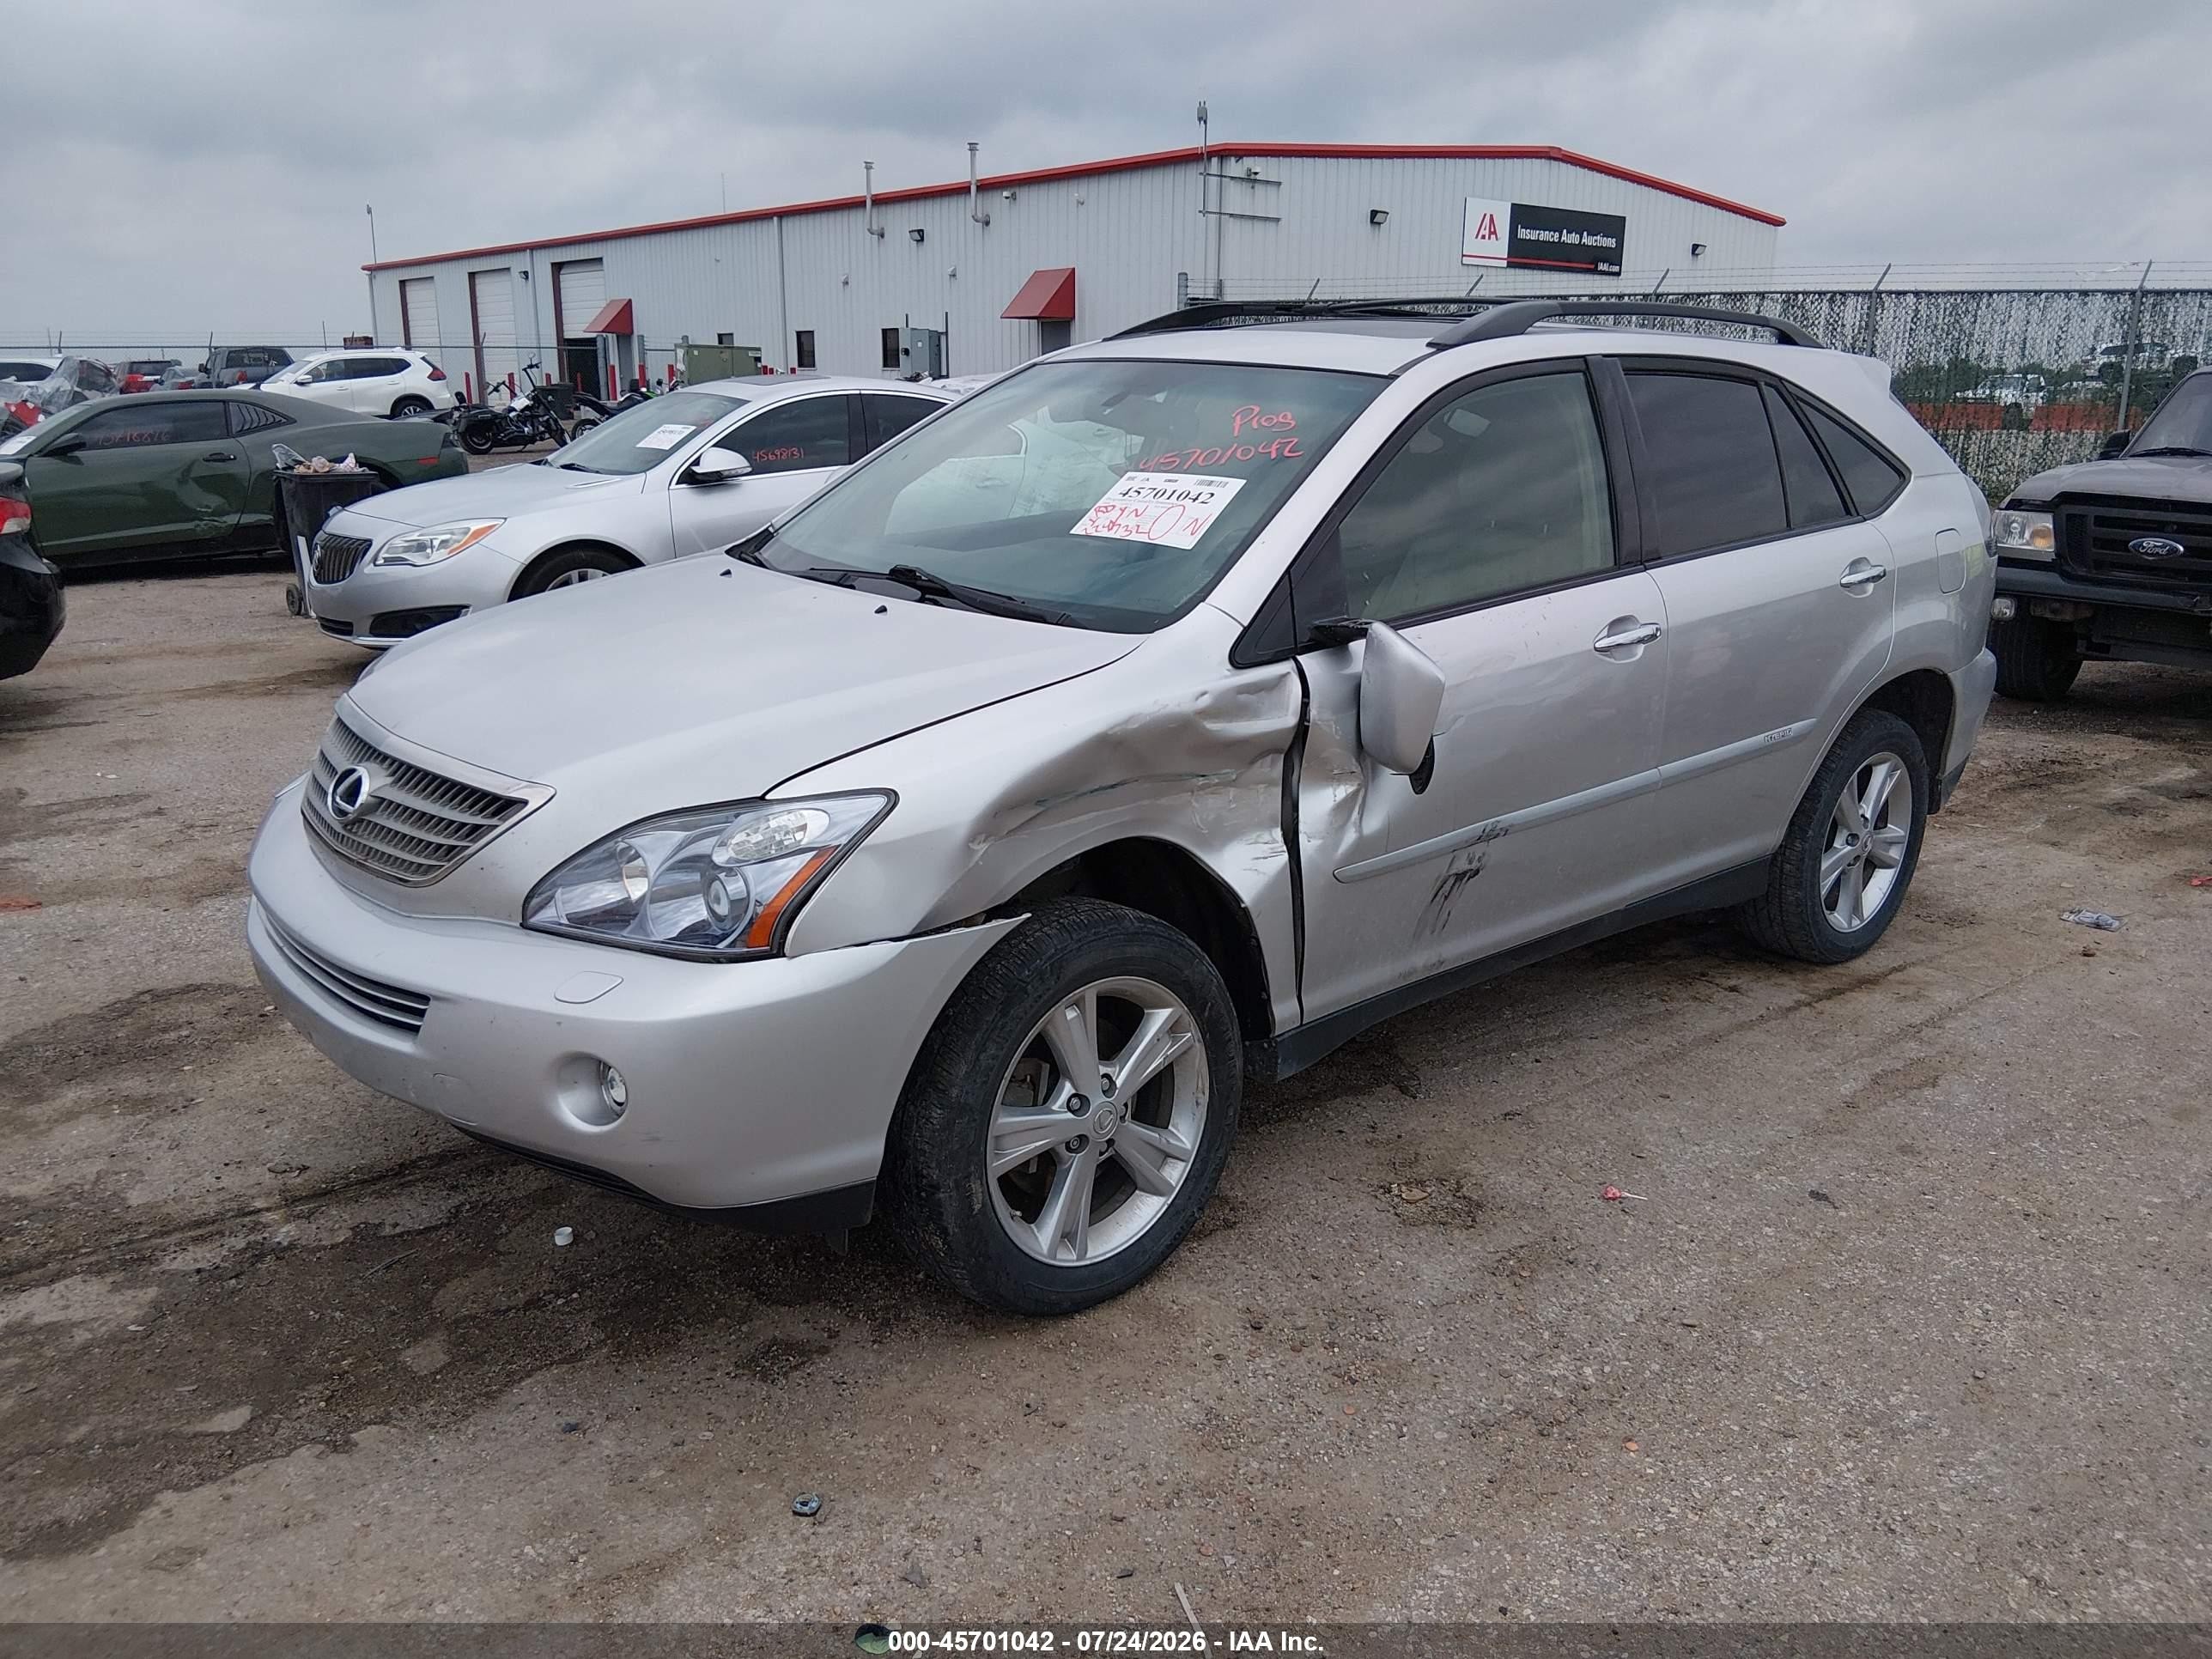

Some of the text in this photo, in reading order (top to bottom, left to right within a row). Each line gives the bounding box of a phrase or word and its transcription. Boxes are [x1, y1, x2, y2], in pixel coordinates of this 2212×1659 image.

[1517, 224, 1617, 249] Insurance Auto Auctions
[1139, 437, 1305, 472] 45701042
[1118, 486, 1216, 505] 45701042
[2139, 540, 2170, 555] Ford
